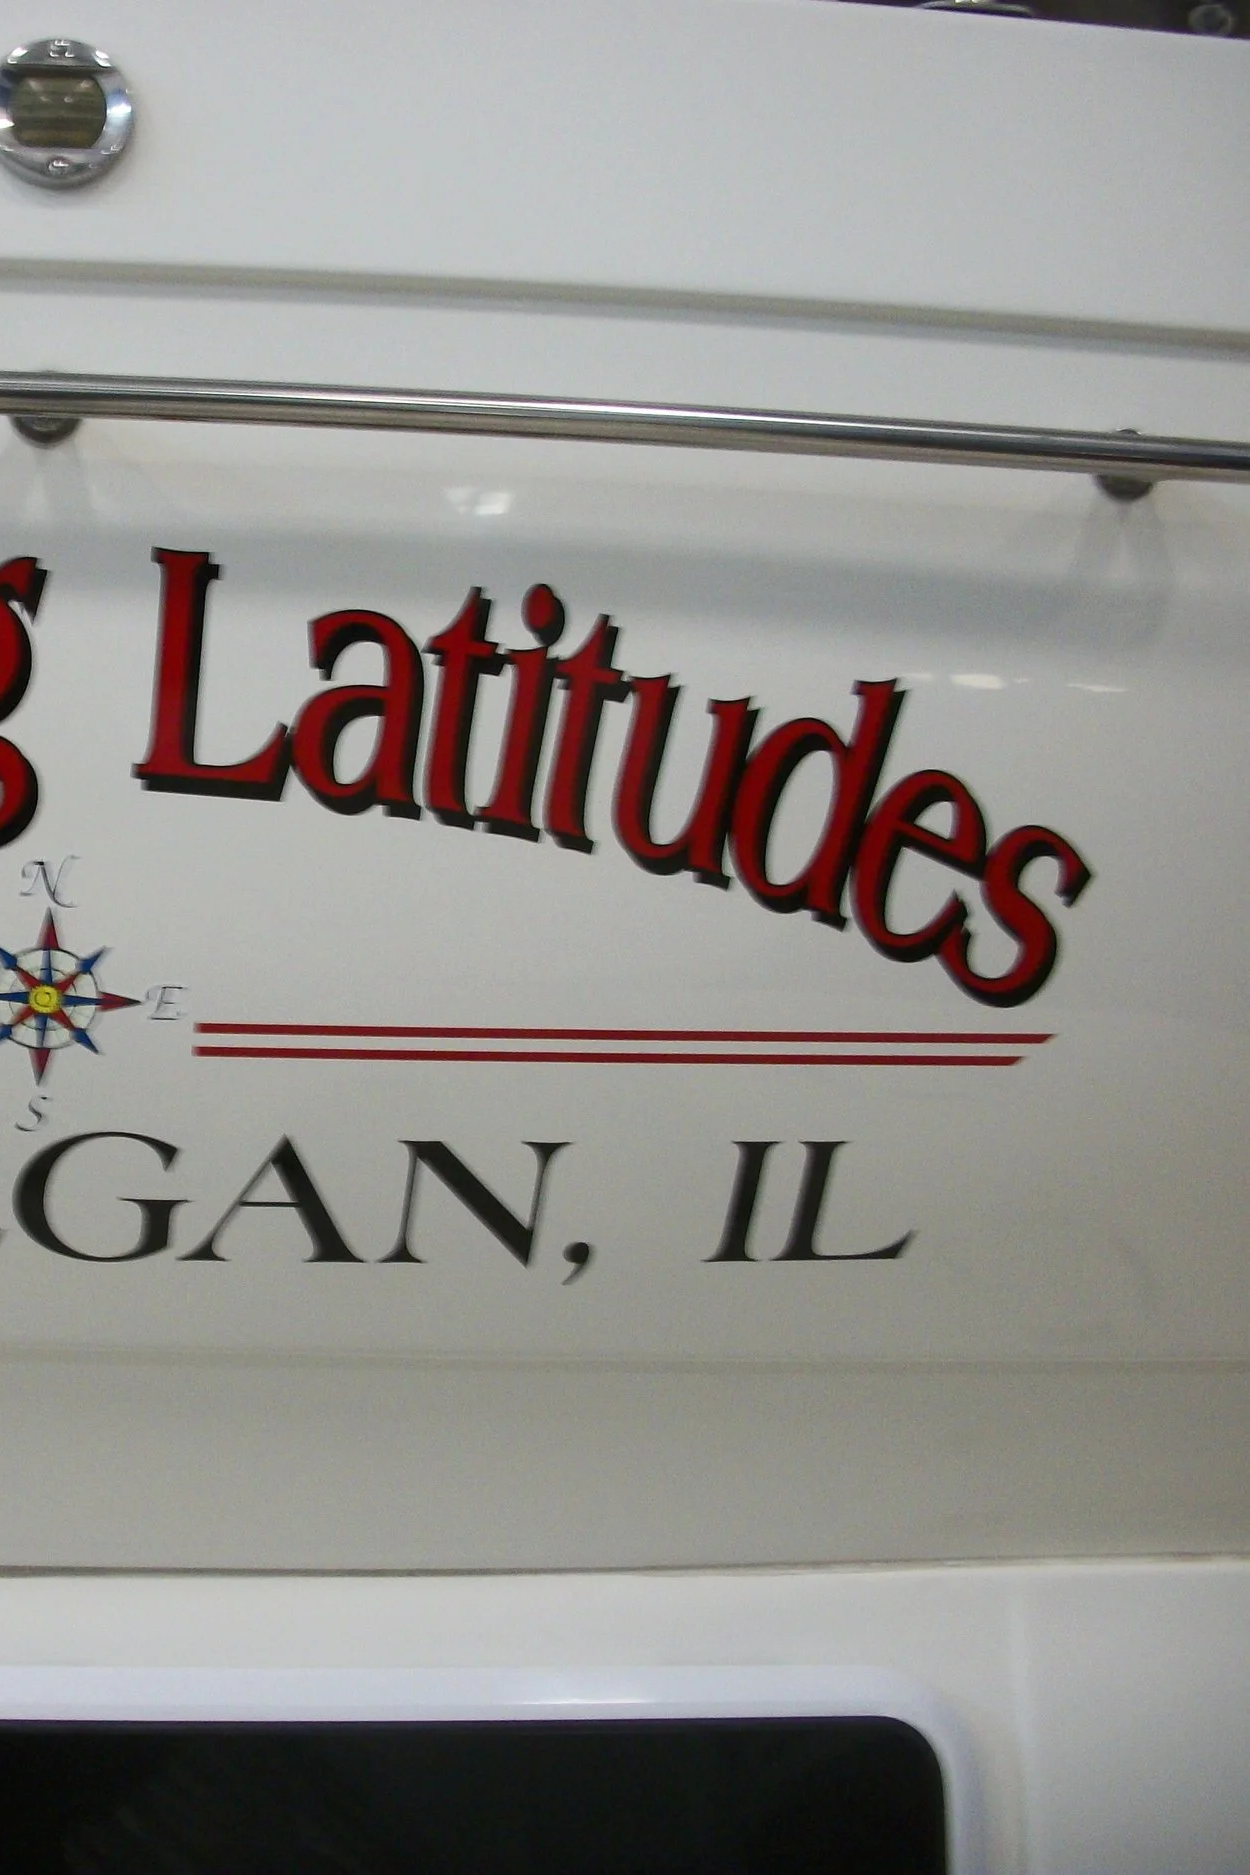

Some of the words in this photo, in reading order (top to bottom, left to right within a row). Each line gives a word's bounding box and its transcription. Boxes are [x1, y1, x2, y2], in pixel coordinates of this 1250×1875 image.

[132, 545, 1096, 1010] Latitudes
[19, 855, 81, 908] N
[145, 985, 188, 1021] E
[14, 1096, 53, 1132] S
[701, 1139, 918, 1264] IL
